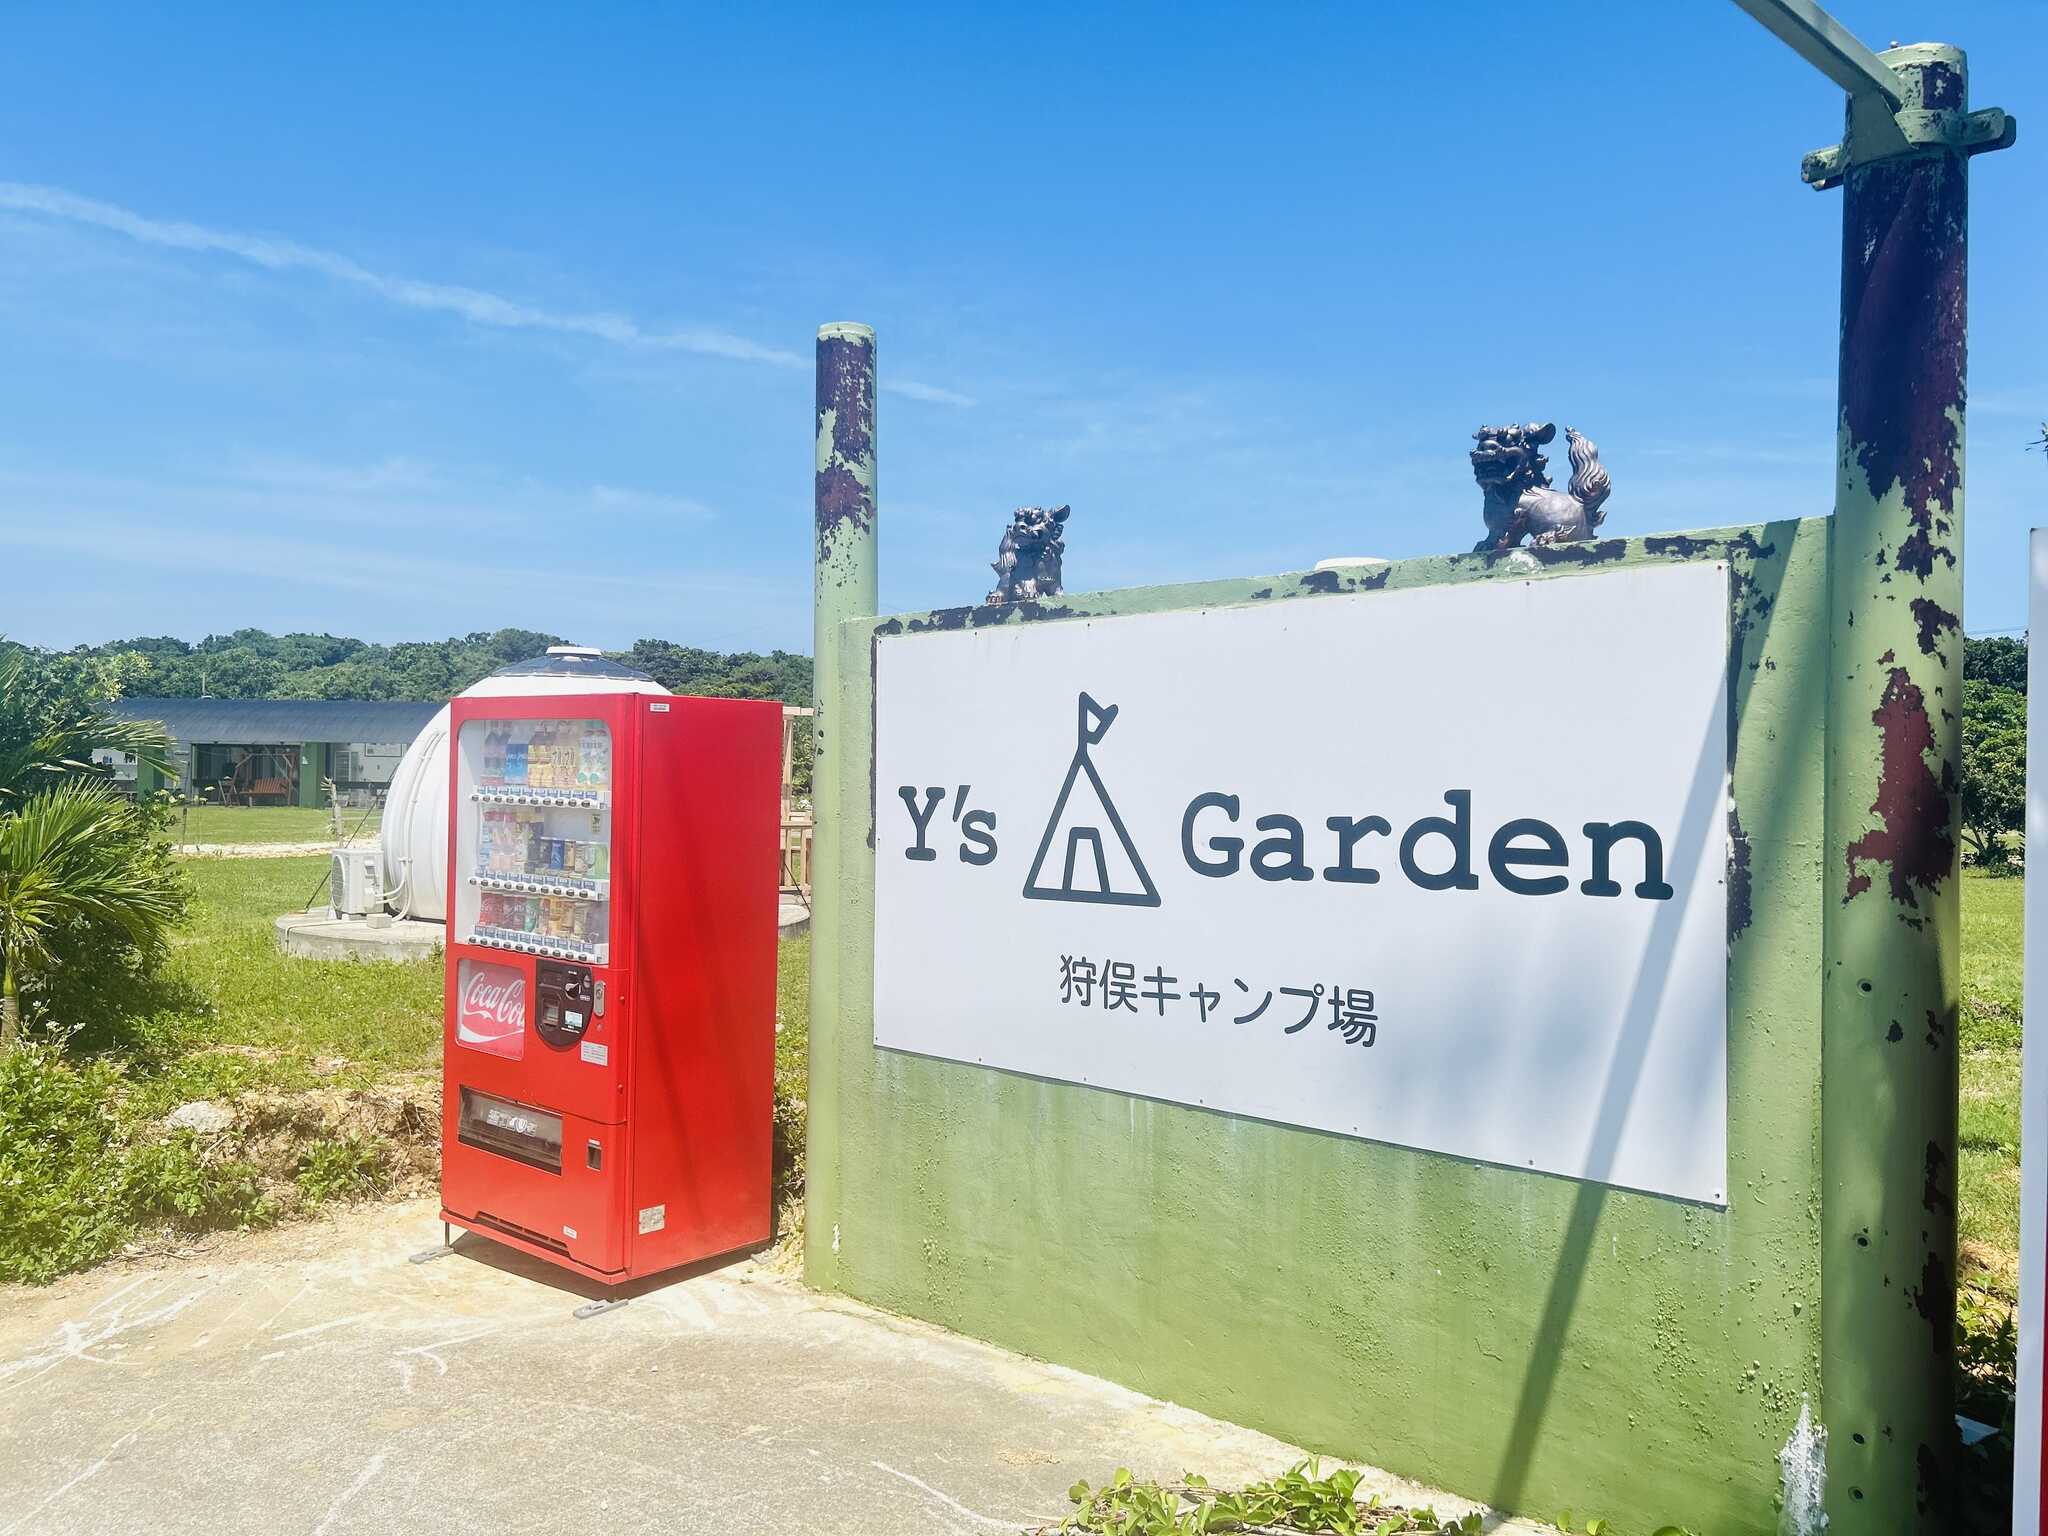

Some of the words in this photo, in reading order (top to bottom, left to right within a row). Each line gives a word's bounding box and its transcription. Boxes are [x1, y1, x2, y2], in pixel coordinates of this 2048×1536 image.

[898, 784, 998, 866] Y's
[1181, 789, 1674, 901] Garden
[1060, 954, 1379, 1048] 狩俣キャンプ場
